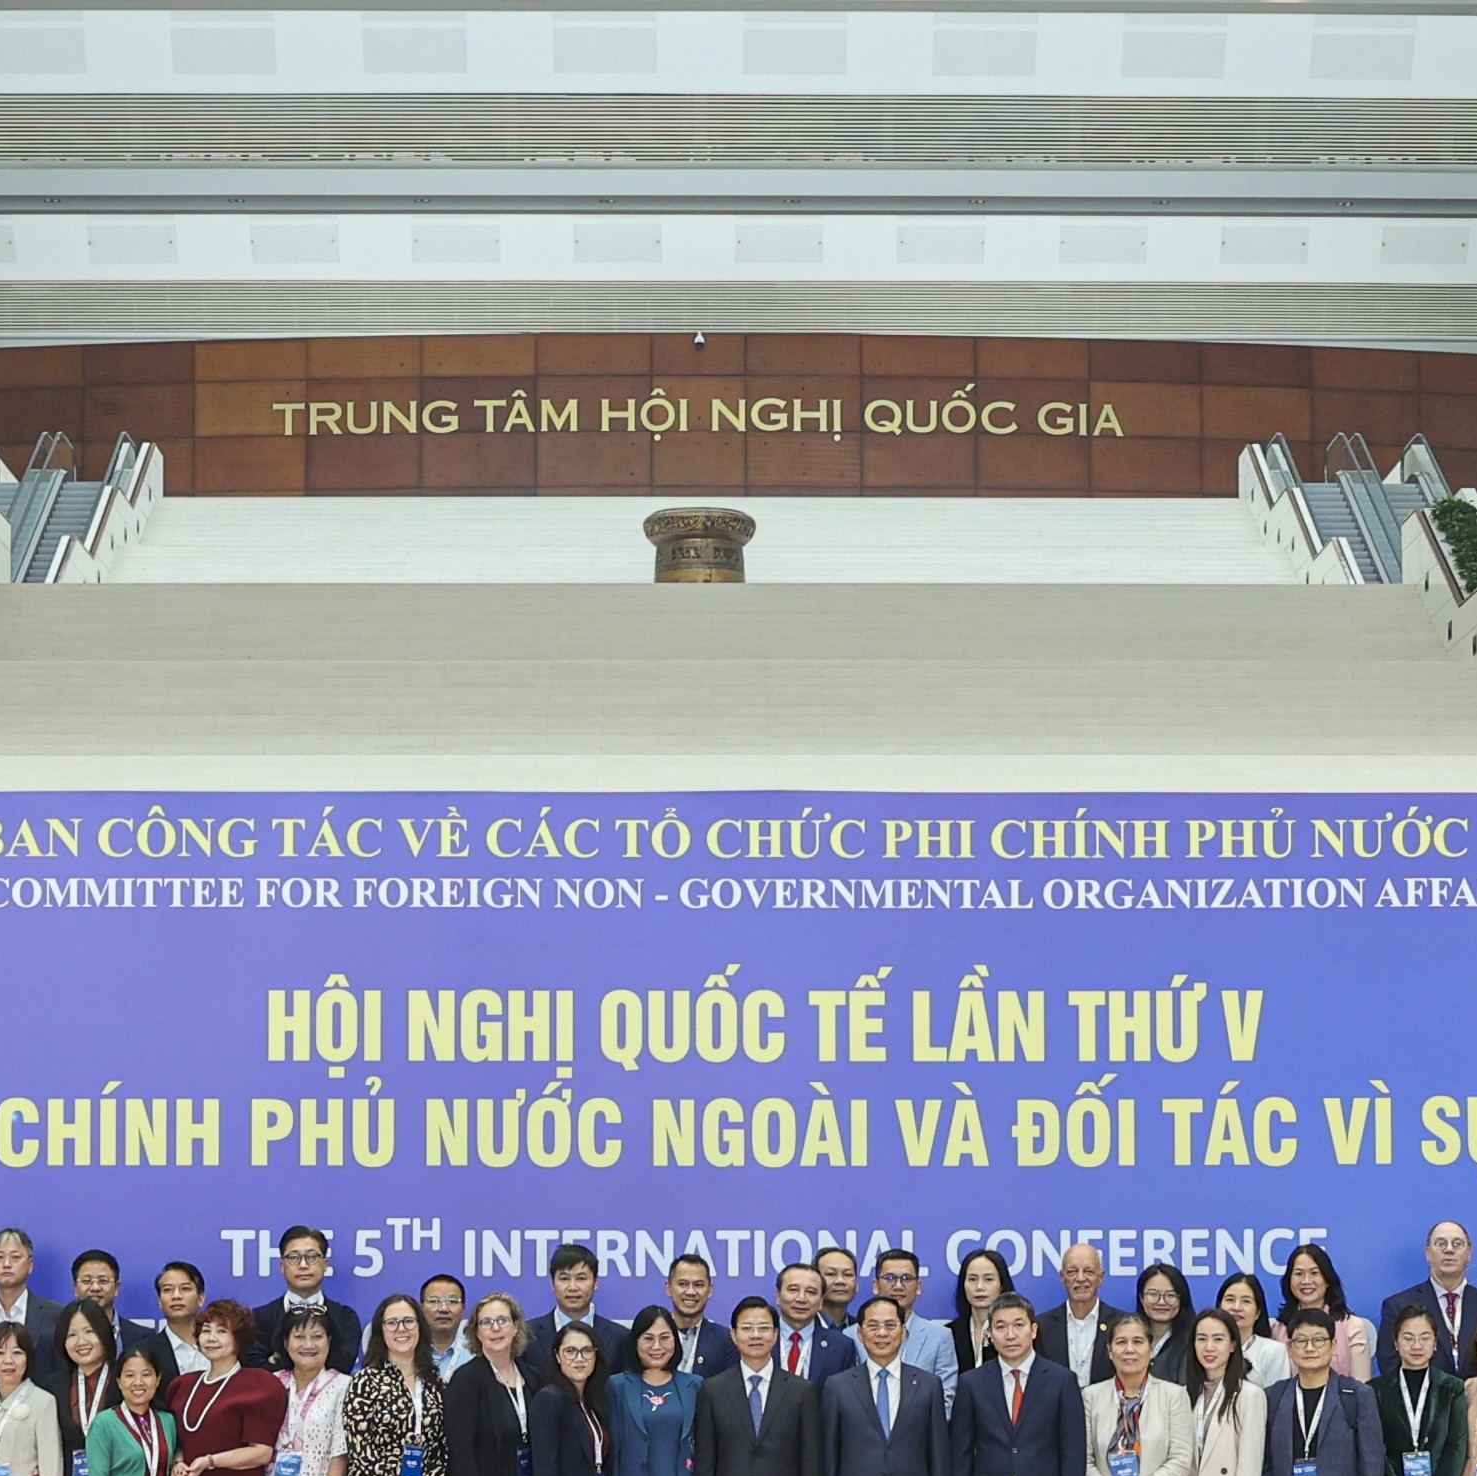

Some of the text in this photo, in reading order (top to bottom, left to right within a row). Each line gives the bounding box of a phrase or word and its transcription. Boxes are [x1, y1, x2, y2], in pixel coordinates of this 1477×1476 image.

[273, 383, 1125, 441] TRUNG TÂM HỘI NGHỊ QUỐC GIA
[98, 807, 257, 857] CÔNG
[272, 807, 382, 857] TÁC
[399, 807, 469, 857] VỀ
[486, 807, 599, 858] CÁC
[615, 805, 690, 858] TỔ
[707, 807, 865, 858] CHỨC
[882, 820, 974, 858] PHI
[991, 808, 1169, 858] CHÍNH
[1187, 806, 1295, 858] PHỦ
[1312, 806, 1468, 857] NƯỚC
[256, 878, 343, 908] FOR
[353, 878, 543, 908] FOREIGN
[554, 878, 644, 908] NON
[680, 878, 1033, 909] GOVERNMENTAL
[1043, 878, 1365, 909] ORGANIZATION
[269, 963, 1263, 1078] HỘI NGHỊ QUỐC TẾ LẦN THỨ V
[252, 1067, 394, 1167] PHỦ
[428, 1074, 621, 1167] NƯỚC
[654, 1083, 867, 1167] NGOÀI
[897, 1083, 988, 1165] VÀ
[1013, 1074, 1135, 1167] ĐỐI
[1164, 1082, 1297, 1166] TÁC
[1325, 1081, 1391, 1164] VÌ
